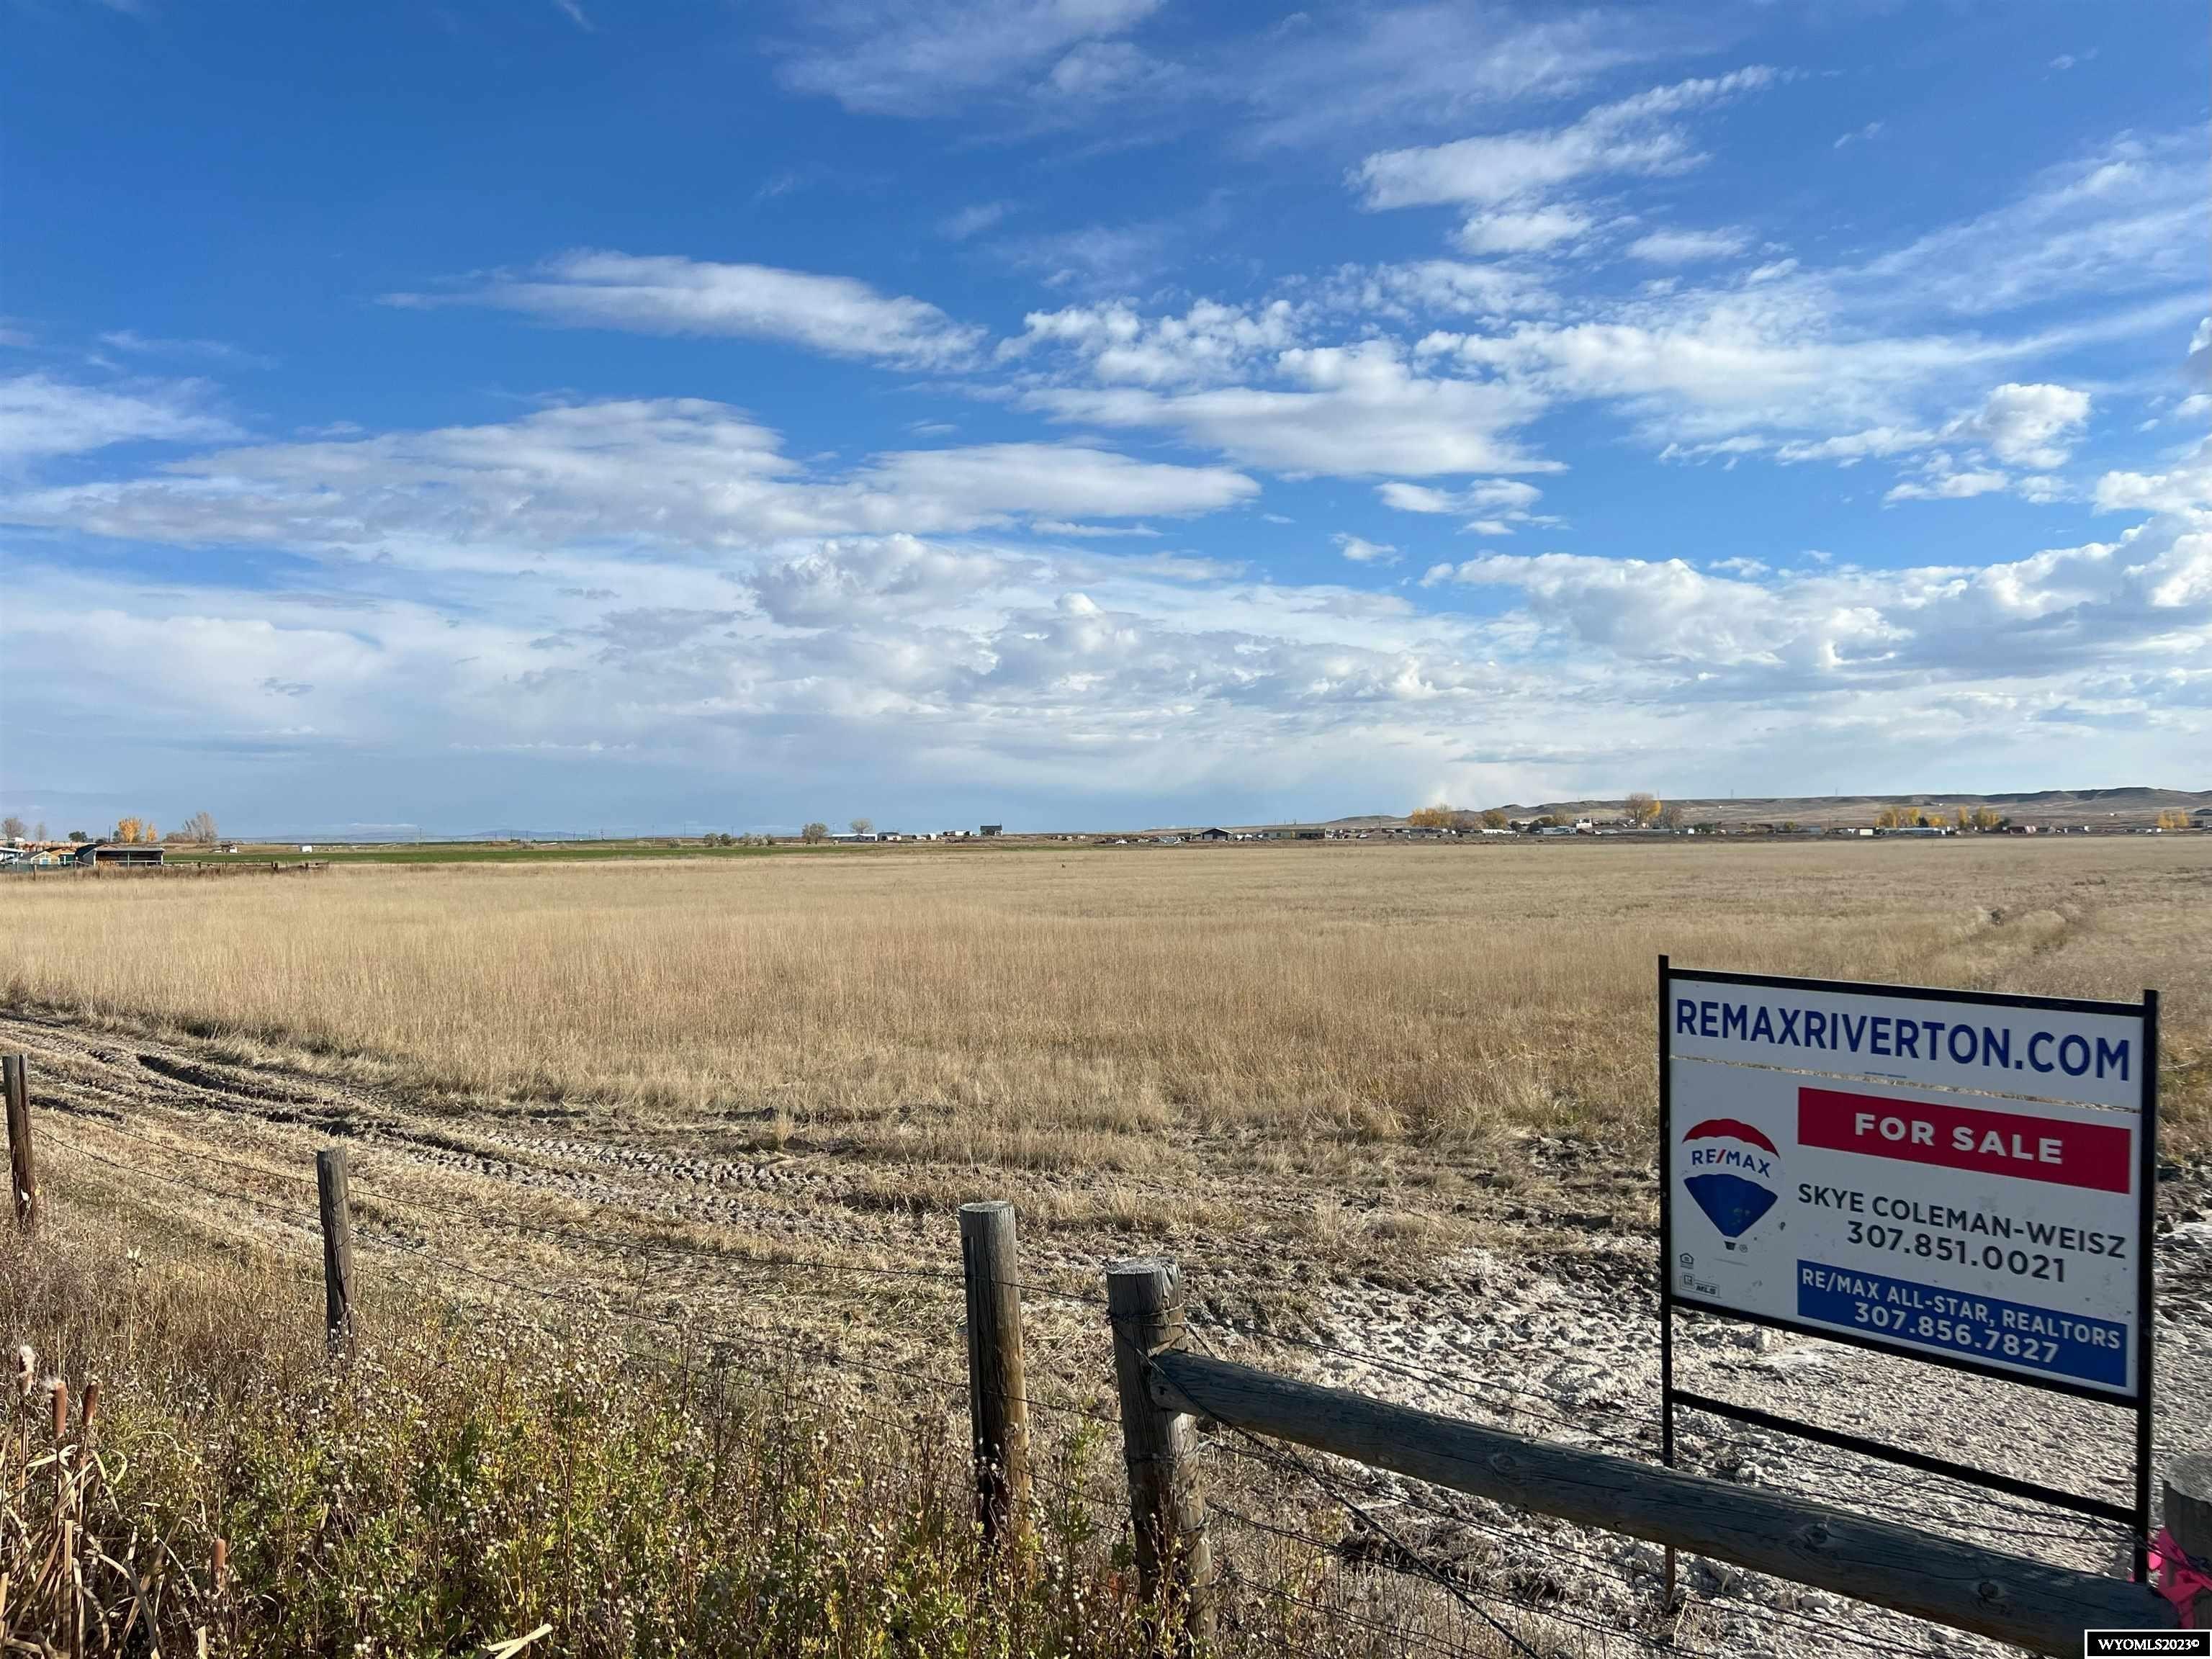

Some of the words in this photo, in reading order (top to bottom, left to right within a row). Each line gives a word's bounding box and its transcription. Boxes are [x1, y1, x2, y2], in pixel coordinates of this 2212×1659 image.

[1676, 999, 2130, 1081] REMAXRIVERTON.COM
[1692, 1149, 1771, 1178] RE/MAX
[1855, 1112, 1934, 1146] FOR
[1951, 1126, 2063, 1165] SALE
[1798, 1183, 1864, 1213] SKYE
[1872, 1196, 2126, 1259] COLEMAN-WEISZ
[1847, 1220, 2066, 1282] 307.851.0021
[1696, 1285, 1717, 1295] MLS
[1802, 1268, 1879, 1300] RE/MAX
[1887, 1285, 1996, 1326] ALL-STAR,
[2002, 1309, 2121, 1349] REALTORS
[1854, 1301, 2059, 1363] 307.856.7827
